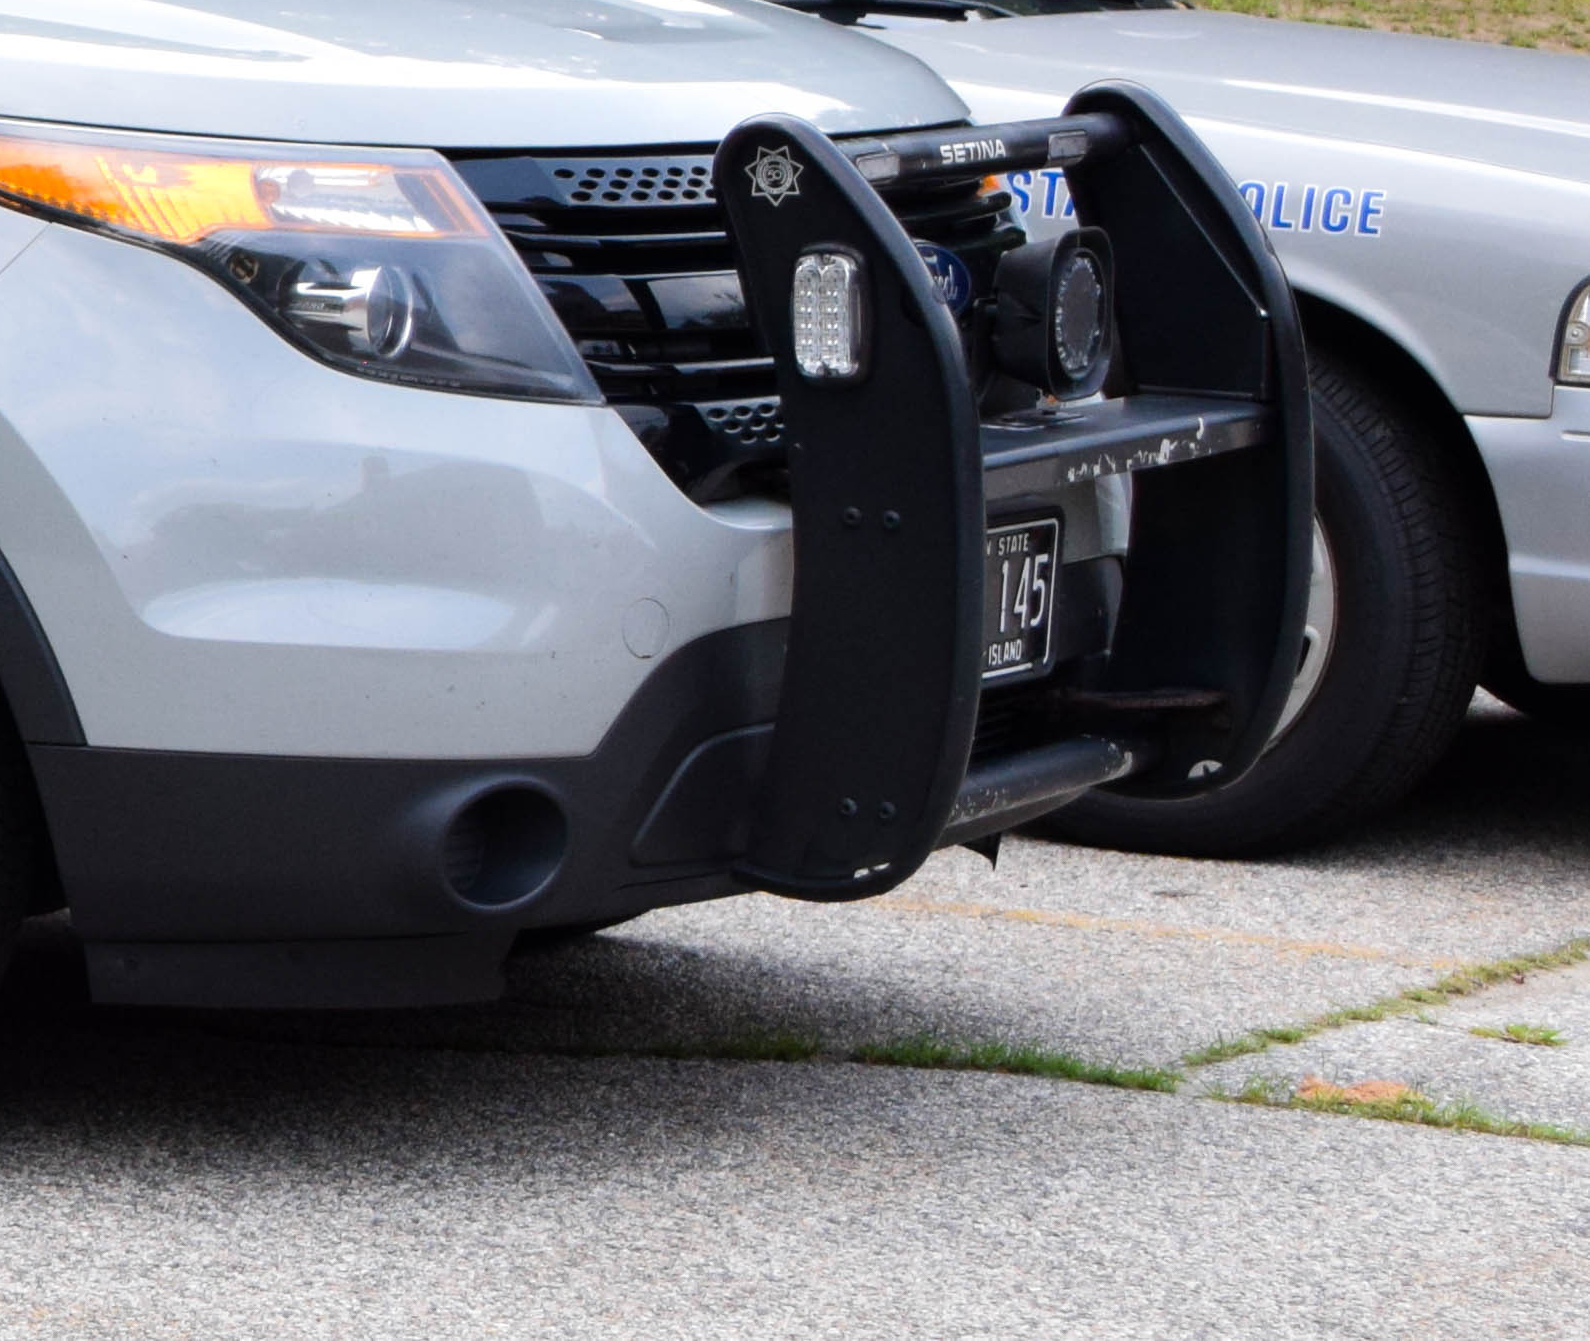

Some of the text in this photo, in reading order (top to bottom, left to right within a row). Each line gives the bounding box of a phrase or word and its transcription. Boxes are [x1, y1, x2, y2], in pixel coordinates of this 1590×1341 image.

[940, 138, 1007, 165] SETINA
[1238, 180, 1387, 237] OLICE
[997, 532, 1030, 555] STATE
[999, 553, 1049, 633] 145
[988, 639, 1023, 667] ISLAND
